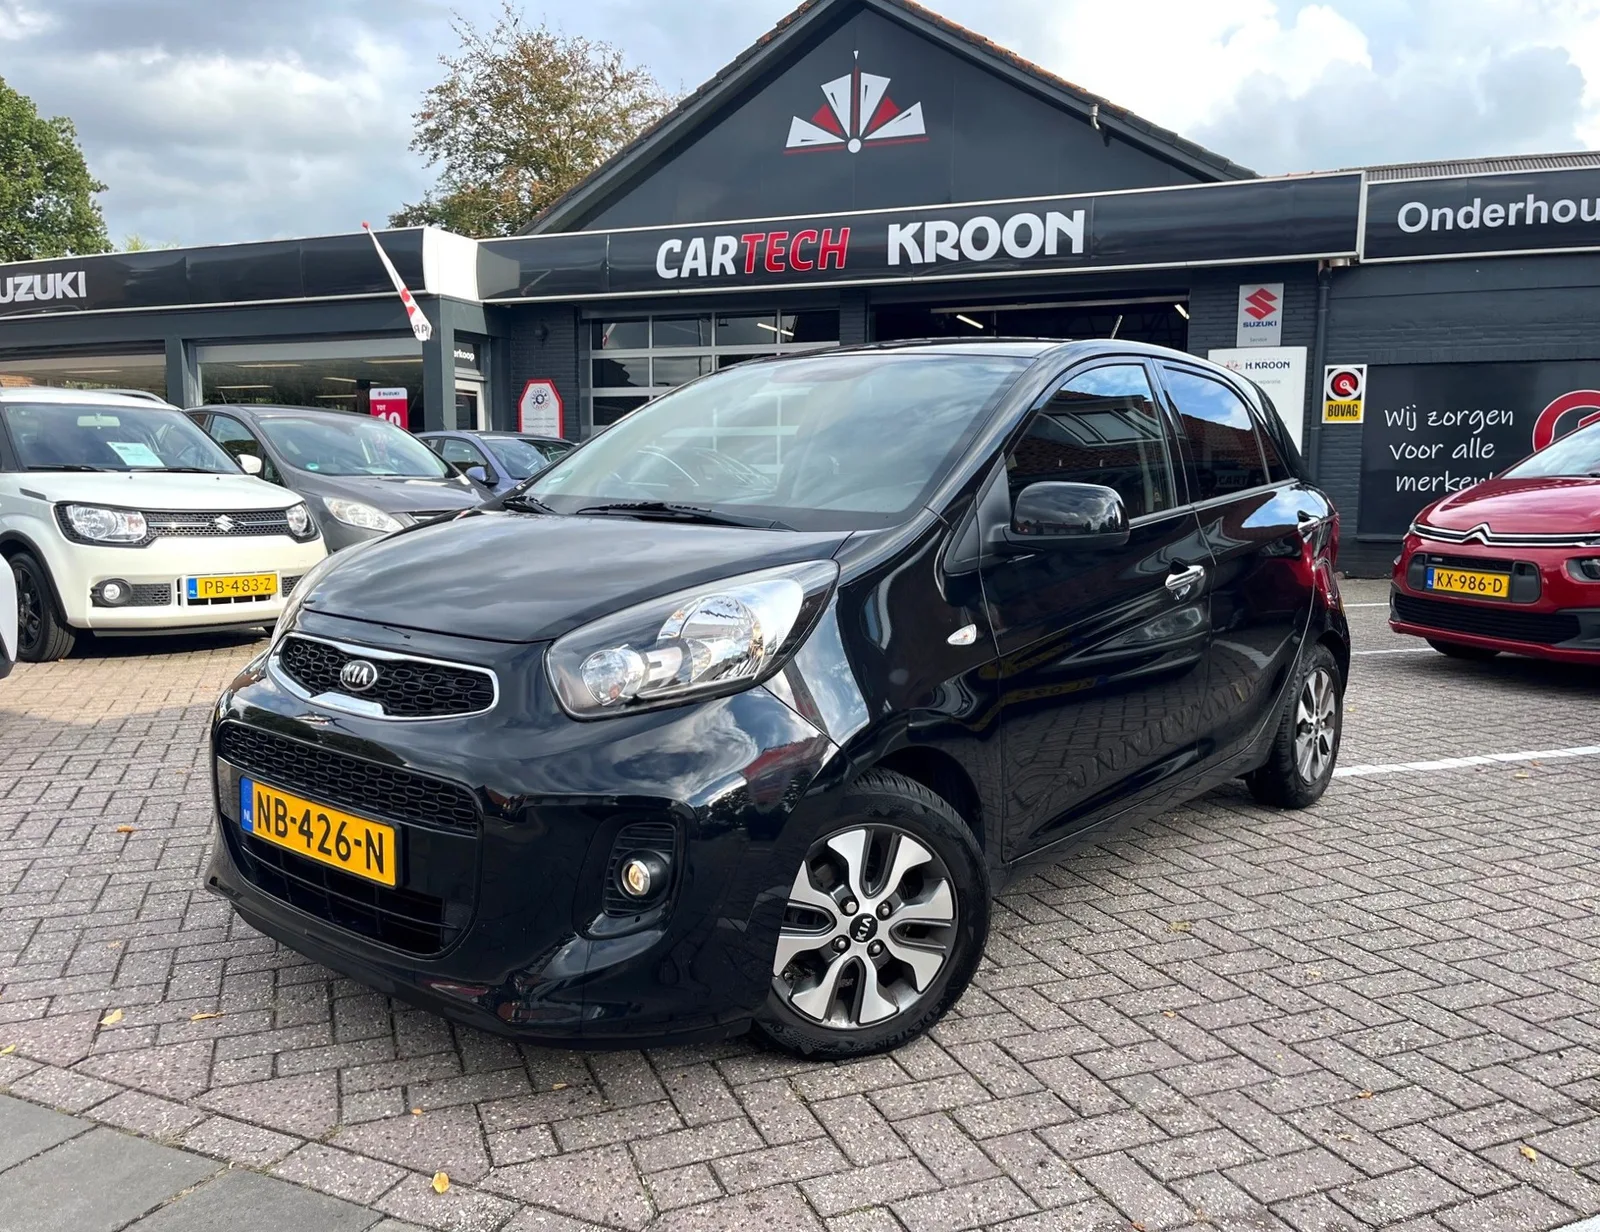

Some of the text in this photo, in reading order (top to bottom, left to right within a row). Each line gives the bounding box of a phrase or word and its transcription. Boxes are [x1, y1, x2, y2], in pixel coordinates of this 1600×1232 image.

[1397, 194, 1600, 233] Onderhou
[655, 210, 1085, 279] CARTECH KROON
[0, 271, 87, 304] UZUKI
[1327, 404, 1358, 418] BOVAG
[1384, 404, 1514, 434] Wij zorgen
[1389, 437, 1495, 460] voor alle
[204, 577, 271, 595] PB-483-Z
[1436, 572, 1503, 593] KX-986-D
[343, 664, 369, 685] KIA
[243, 791, 385, 875] NL NB-426-N
[855, 917, 872, 941] KIA
